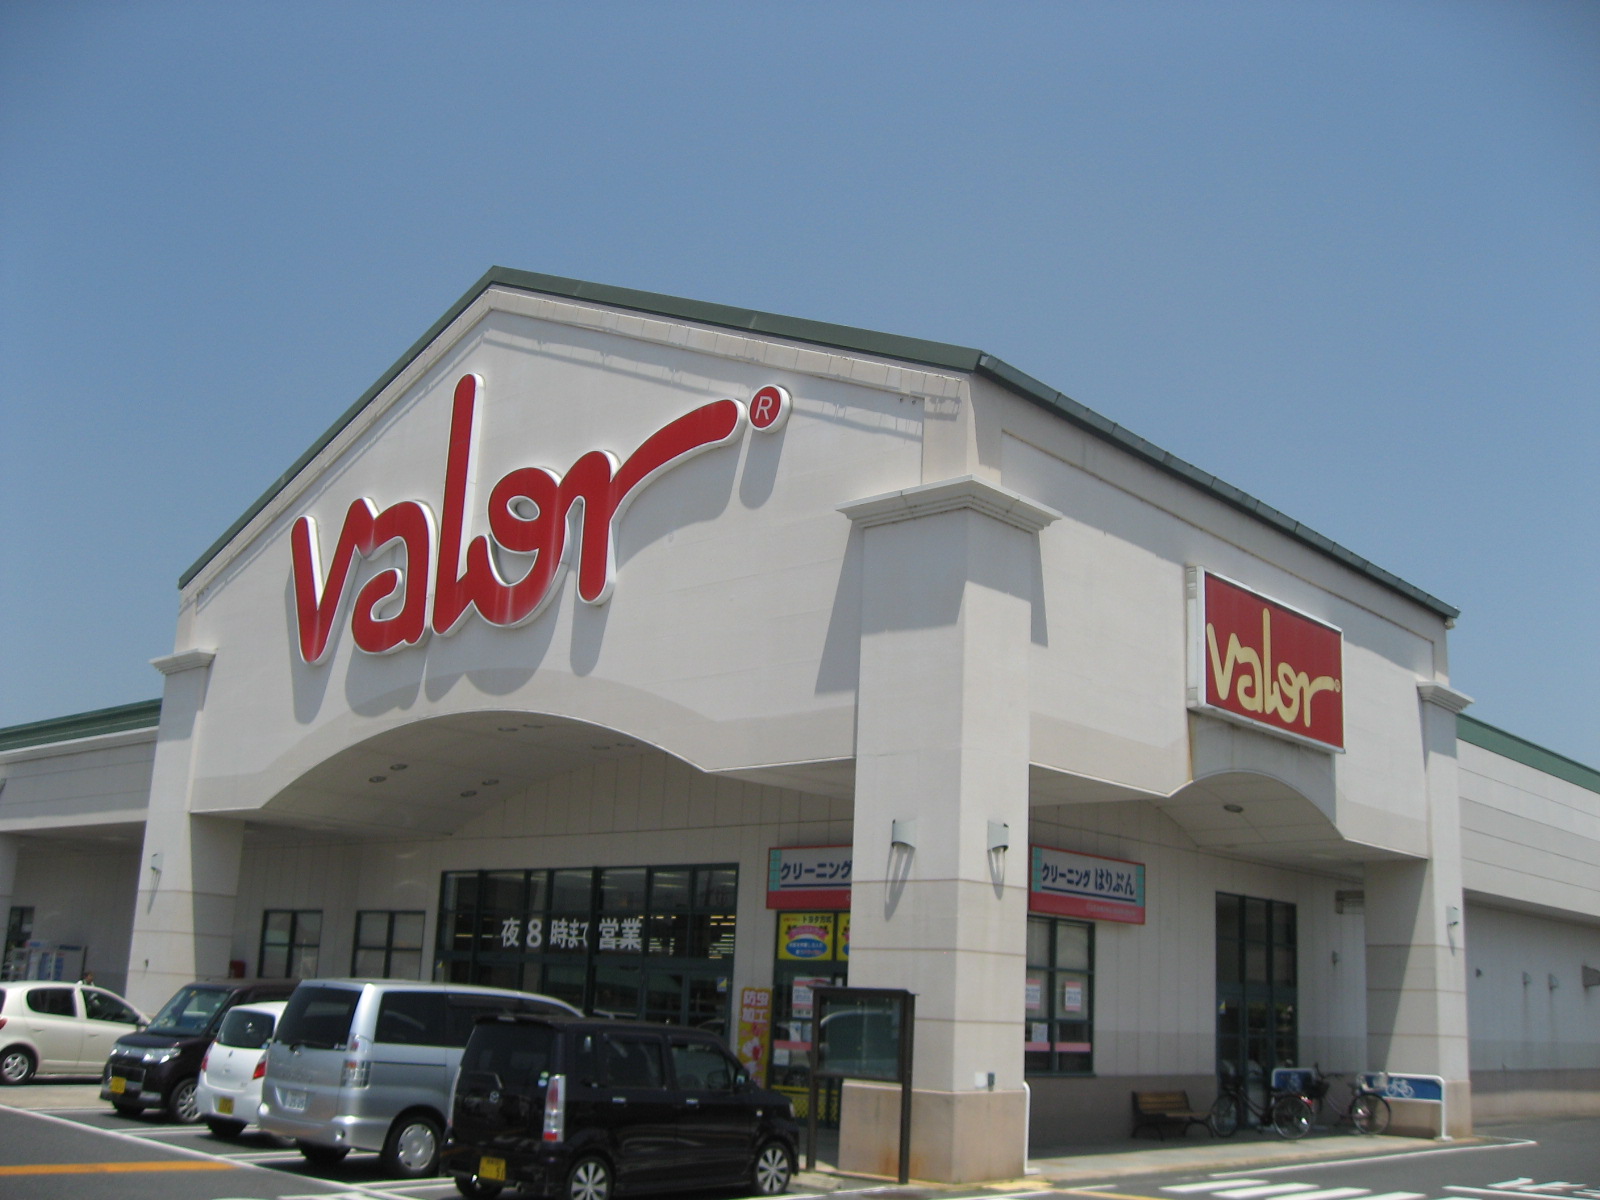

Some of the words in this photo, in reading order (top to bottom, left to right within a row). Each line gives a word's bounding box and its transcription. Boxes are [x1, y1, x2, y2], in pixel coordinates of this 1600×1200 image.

[781, 861, 852, 880] クリーニング
[1042, 864, 1090, 887] クリーニング
